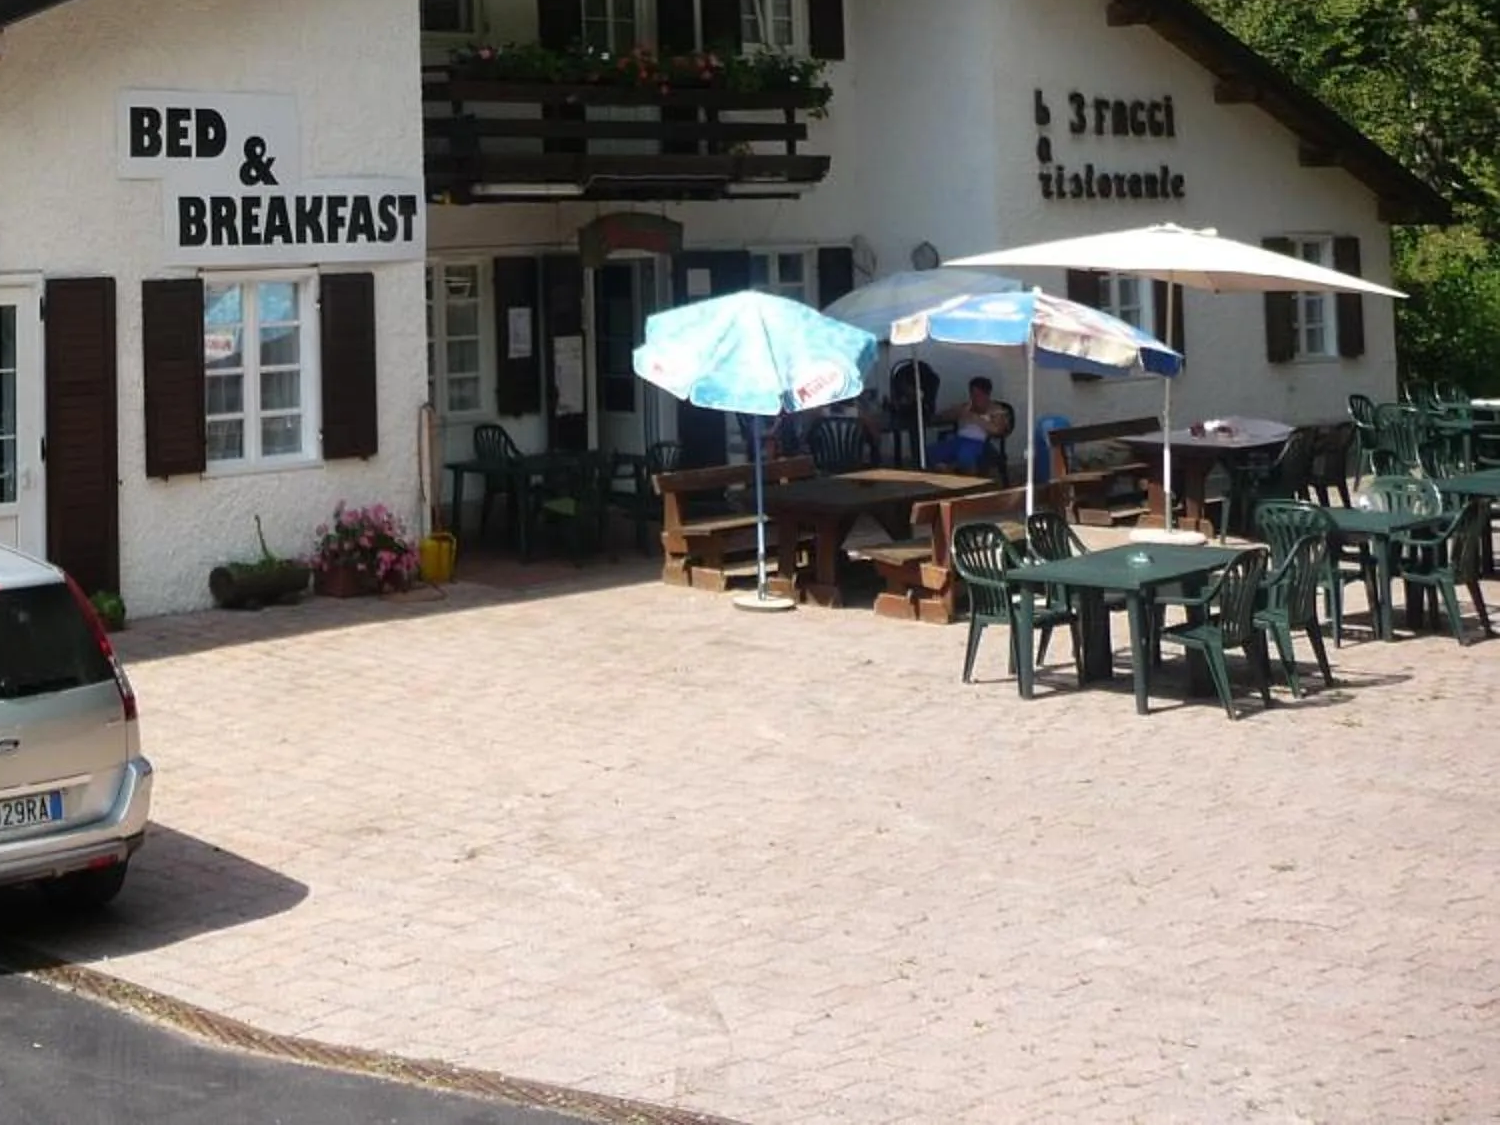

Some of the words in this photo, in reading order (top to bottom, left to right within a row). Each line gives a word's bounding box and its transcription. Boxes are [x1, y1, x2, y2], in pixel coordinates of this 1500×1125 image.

[1067, 91, 1087, 134] 3
[129, 106, 227, 158] BED
[239, 136, 279, 186] &
[177, 194, 418, 248] BREAKFAST
